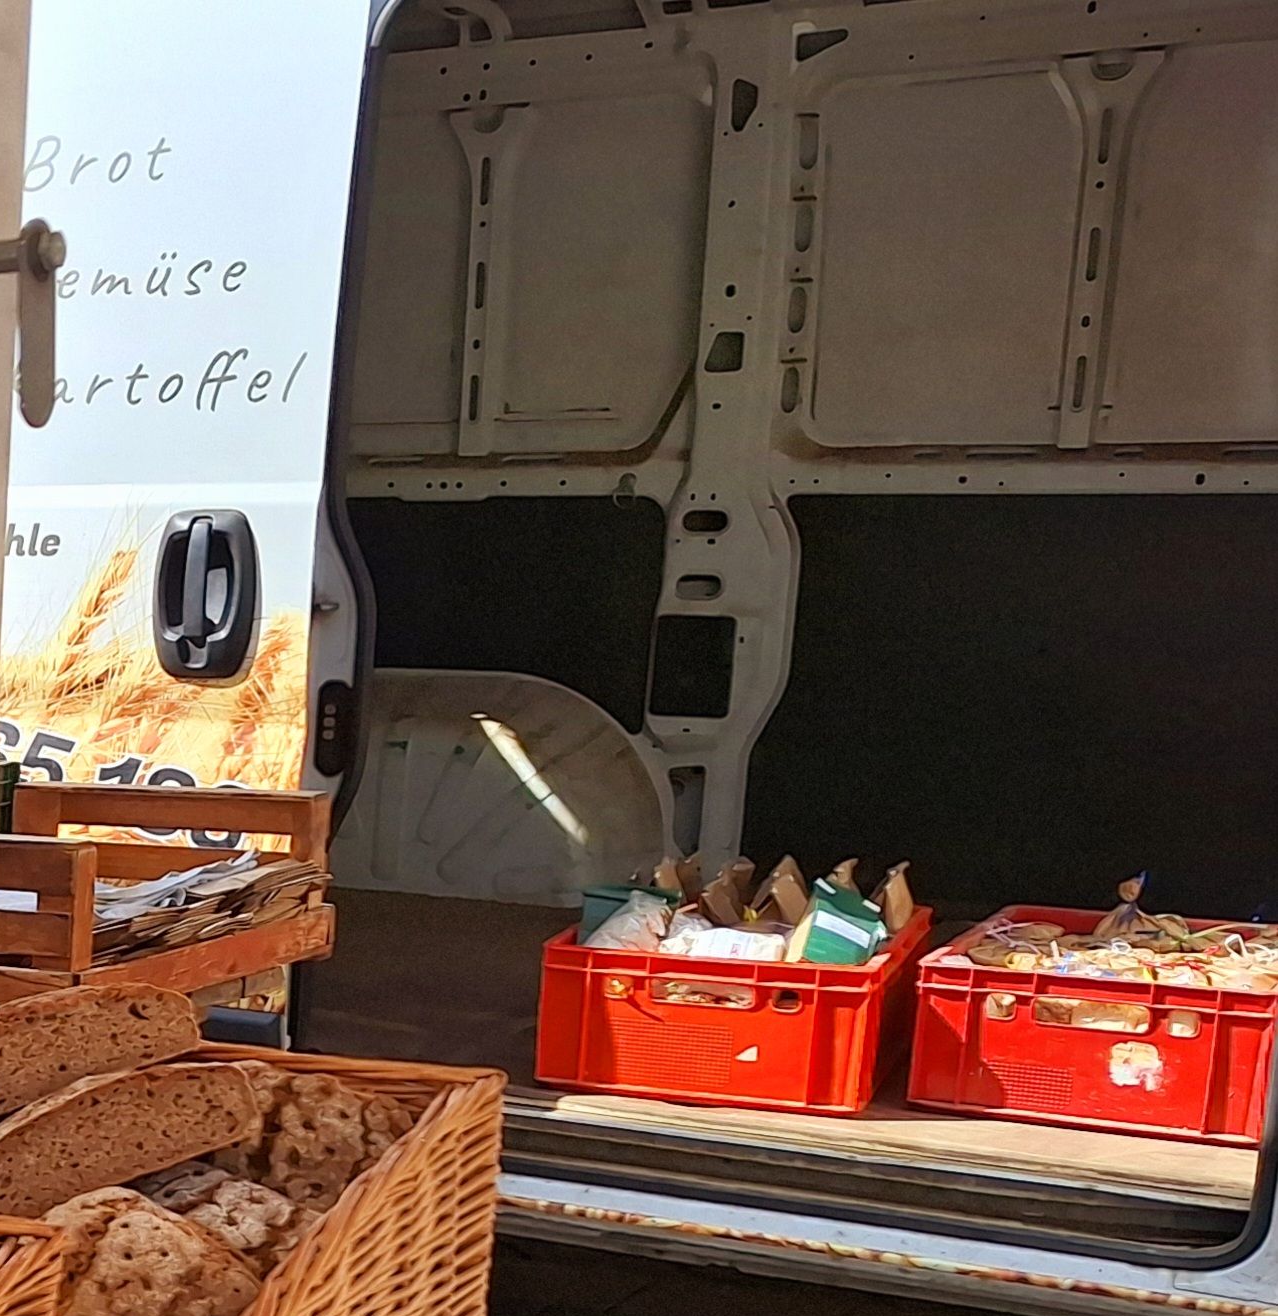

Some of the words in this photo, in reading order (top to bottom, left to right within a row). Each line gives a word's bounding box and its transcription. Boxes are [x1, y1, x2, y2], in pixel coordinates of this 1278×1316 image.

[23, 135, 172, 192] Brot
[55, 252, 247, 298] emüse
[52, 348, 308, 411] artoffel
[4, 523, 61, 556] hle
